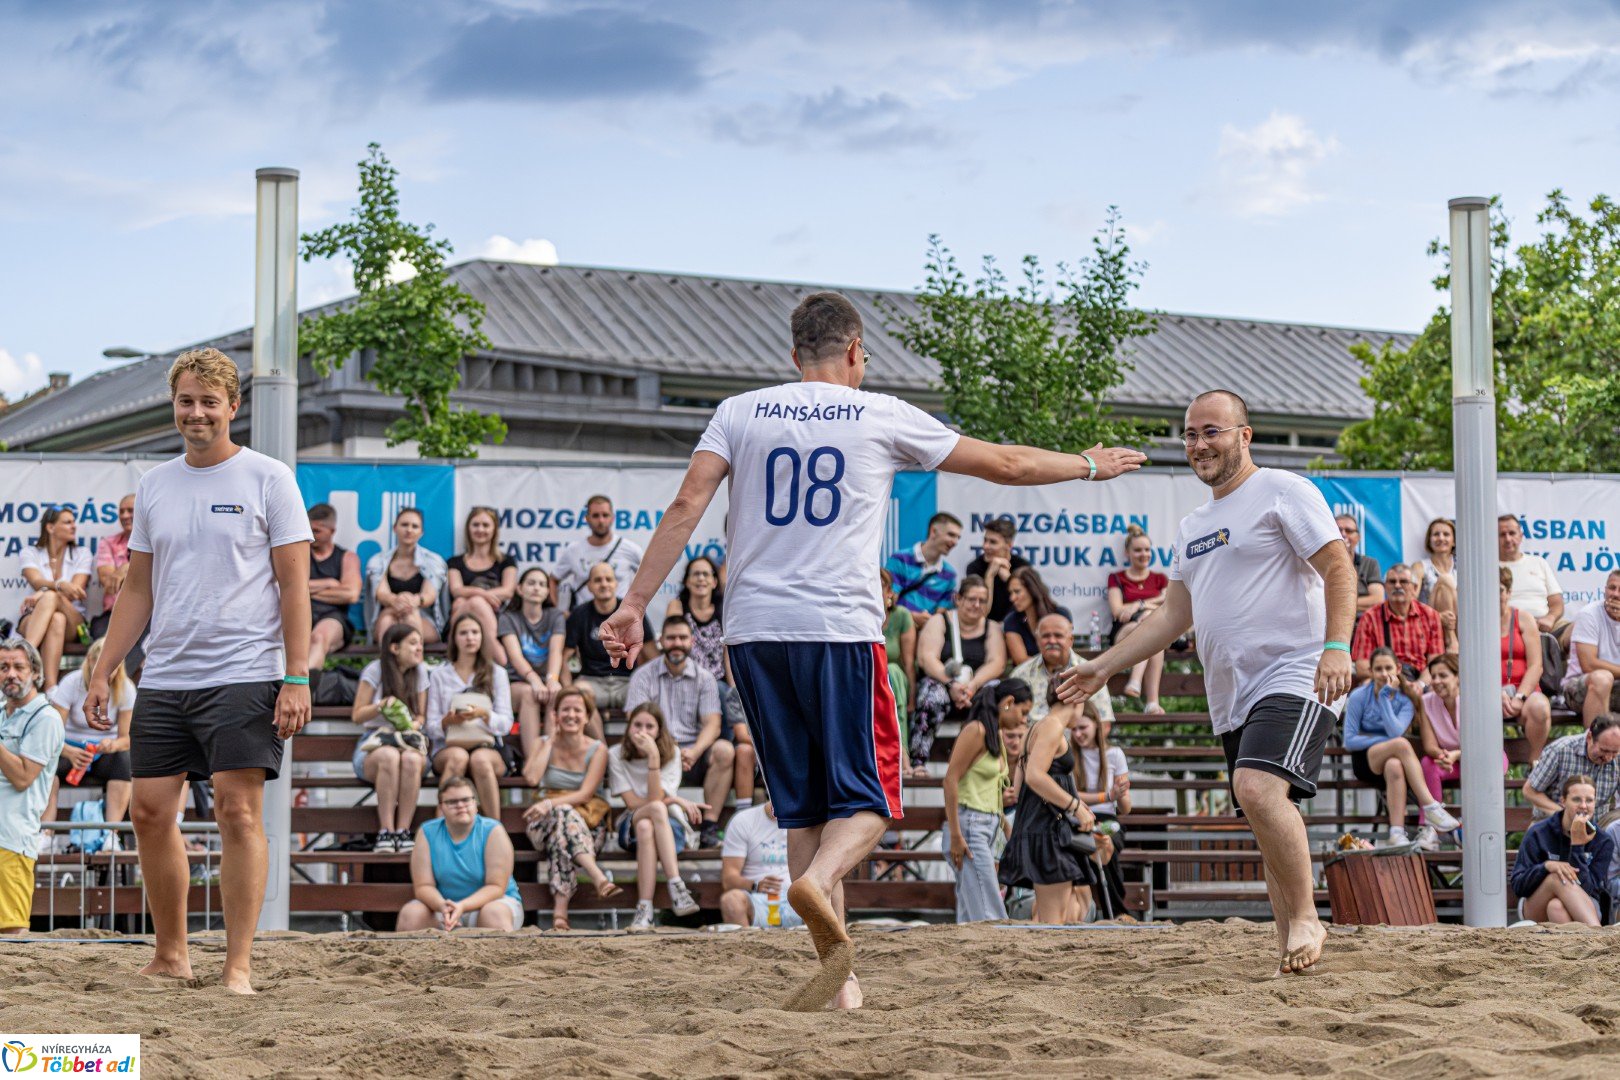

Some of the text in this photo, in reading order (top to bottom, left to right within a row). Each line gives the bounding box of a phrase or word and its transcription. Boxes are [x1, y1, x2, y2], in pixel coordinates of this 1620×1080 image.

[1475, 389, 1487, 397] 36
[755, 402, 865, 421] HANSÁGHY
[765, 446, 845, 527] 08
[1190, 537, 1216, 555] TRÉNER
[1098, 547, 1117, 567] A
[1557, 552, 1576, 572] A
